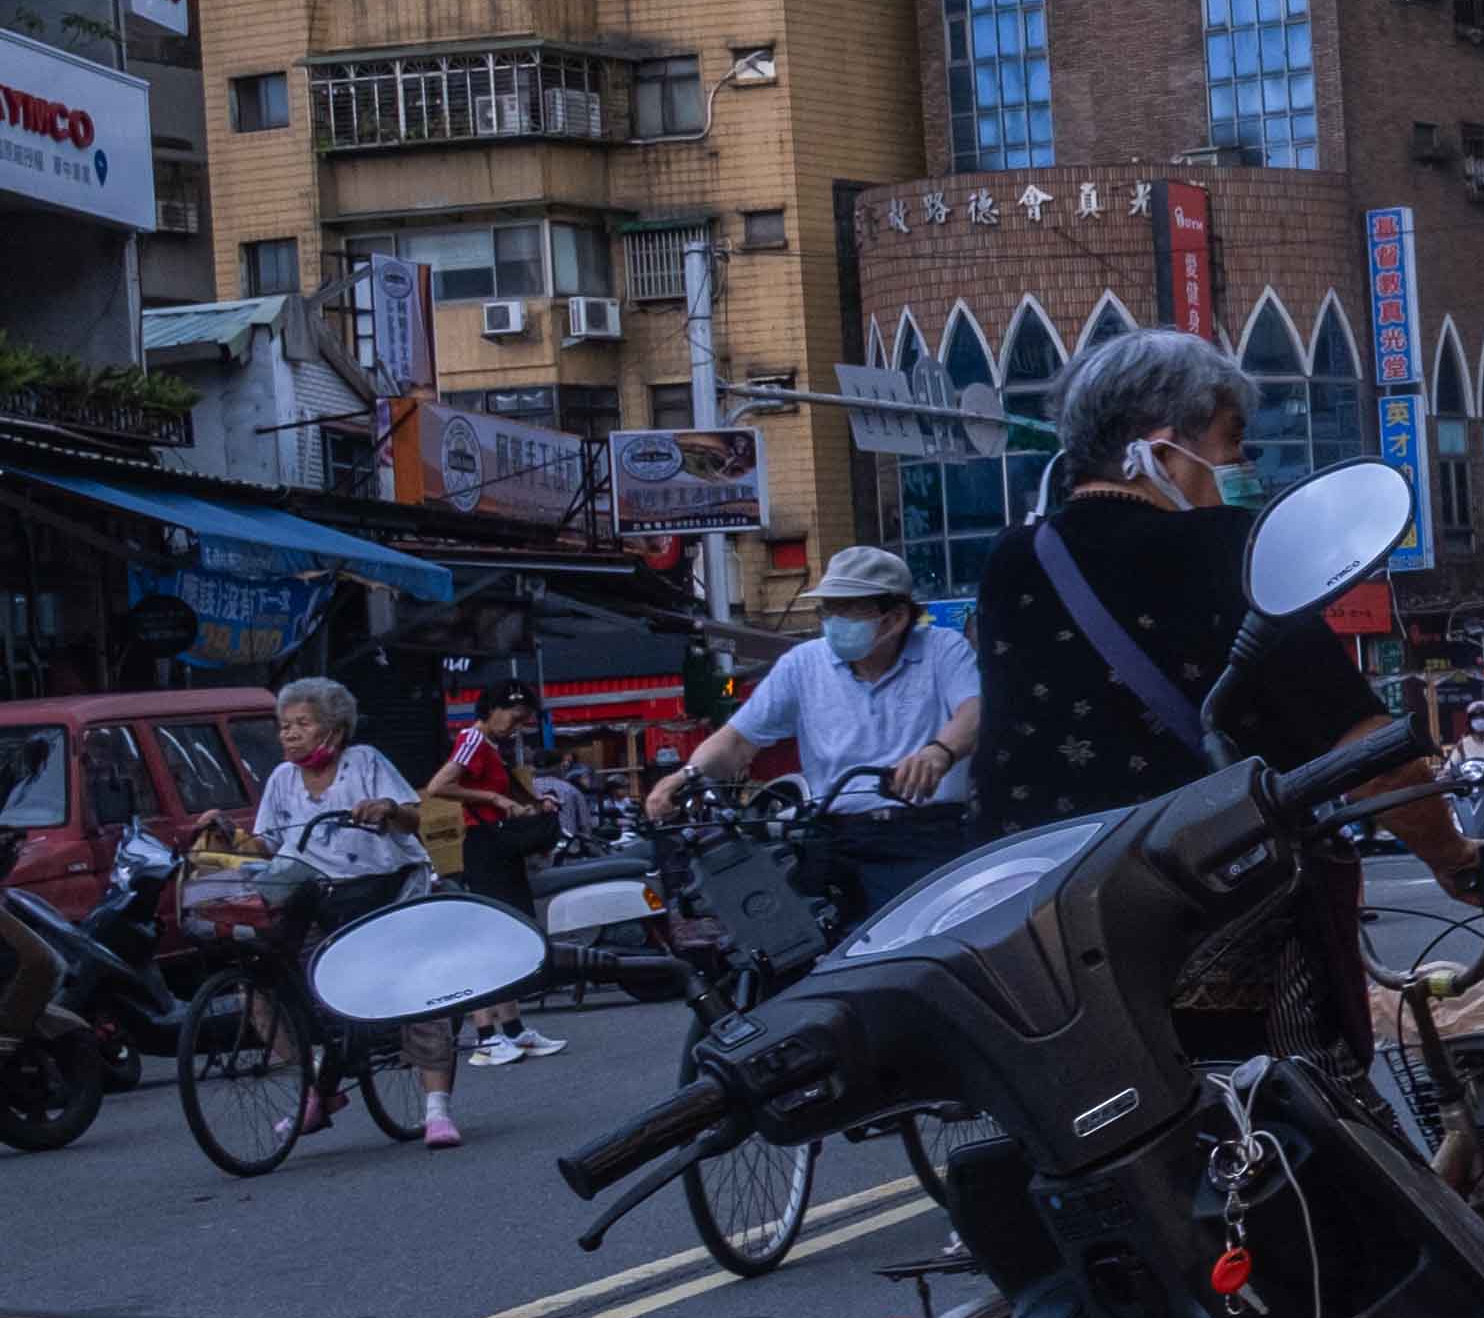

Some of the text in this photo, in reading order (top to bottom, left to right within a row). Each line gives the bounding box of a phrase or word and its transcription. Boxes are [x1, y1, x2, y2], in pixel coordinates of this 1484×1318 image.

[1373, 214, 1409, 380] 基督教真光堂
